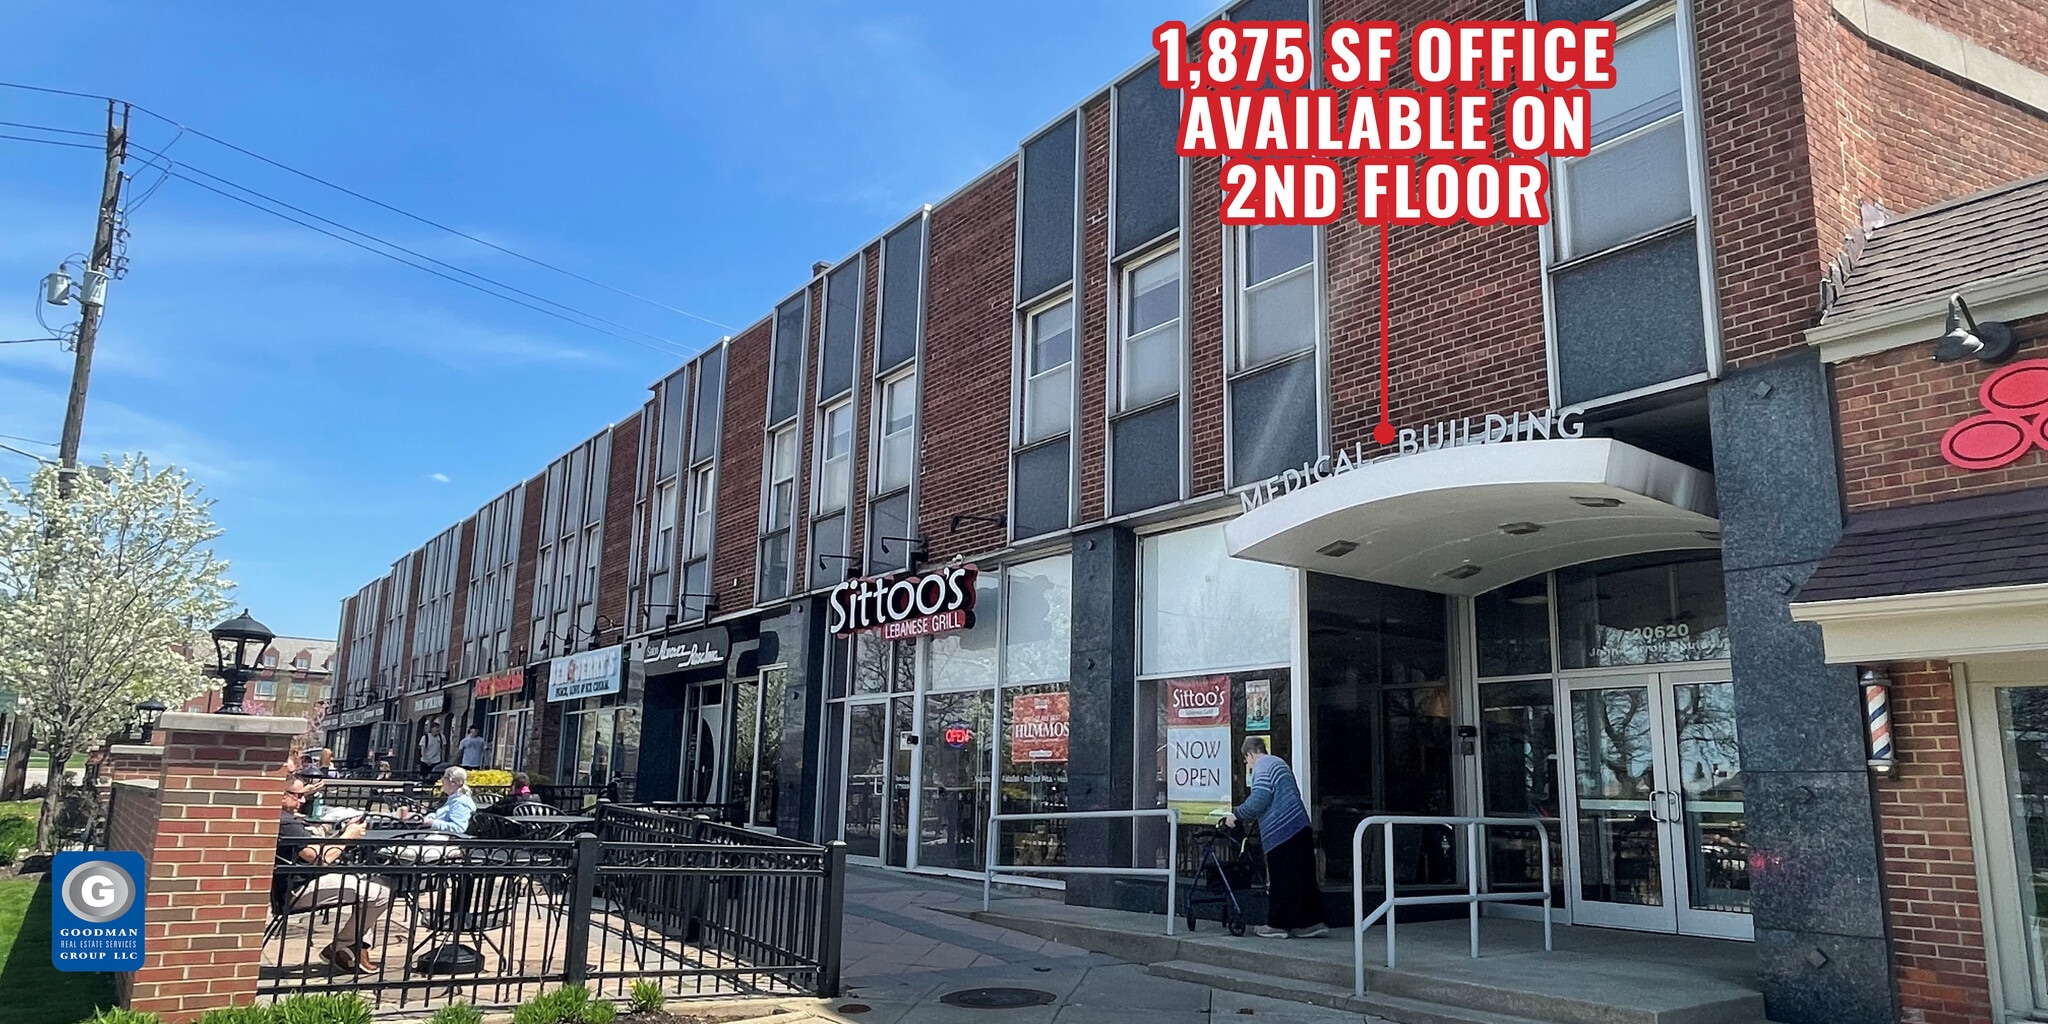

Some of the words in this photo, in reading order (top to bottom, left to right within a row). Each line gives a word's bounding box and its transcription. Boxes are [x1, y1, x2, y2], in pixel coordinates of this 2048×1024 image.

[1240, 441, 1374, 514] MEDICAL
[1399, 407, 1586, 457] BUILDING
[830, 567, 966, 634] Sittoo's
[884, 617, 928, 639] LEBANESE
[931, 611, 961, 632] GRILL
[1632, 623, 1689, 639] 20620
[1173, 685, 1225, 708] Sittoo's
[945, 728, 969, 743] OPEN
[1015, 722, 1070, 738] HUMMOS
[1176, 740, 1220, 759] NOW
[1175, 768, 1220, 786] OPEN
